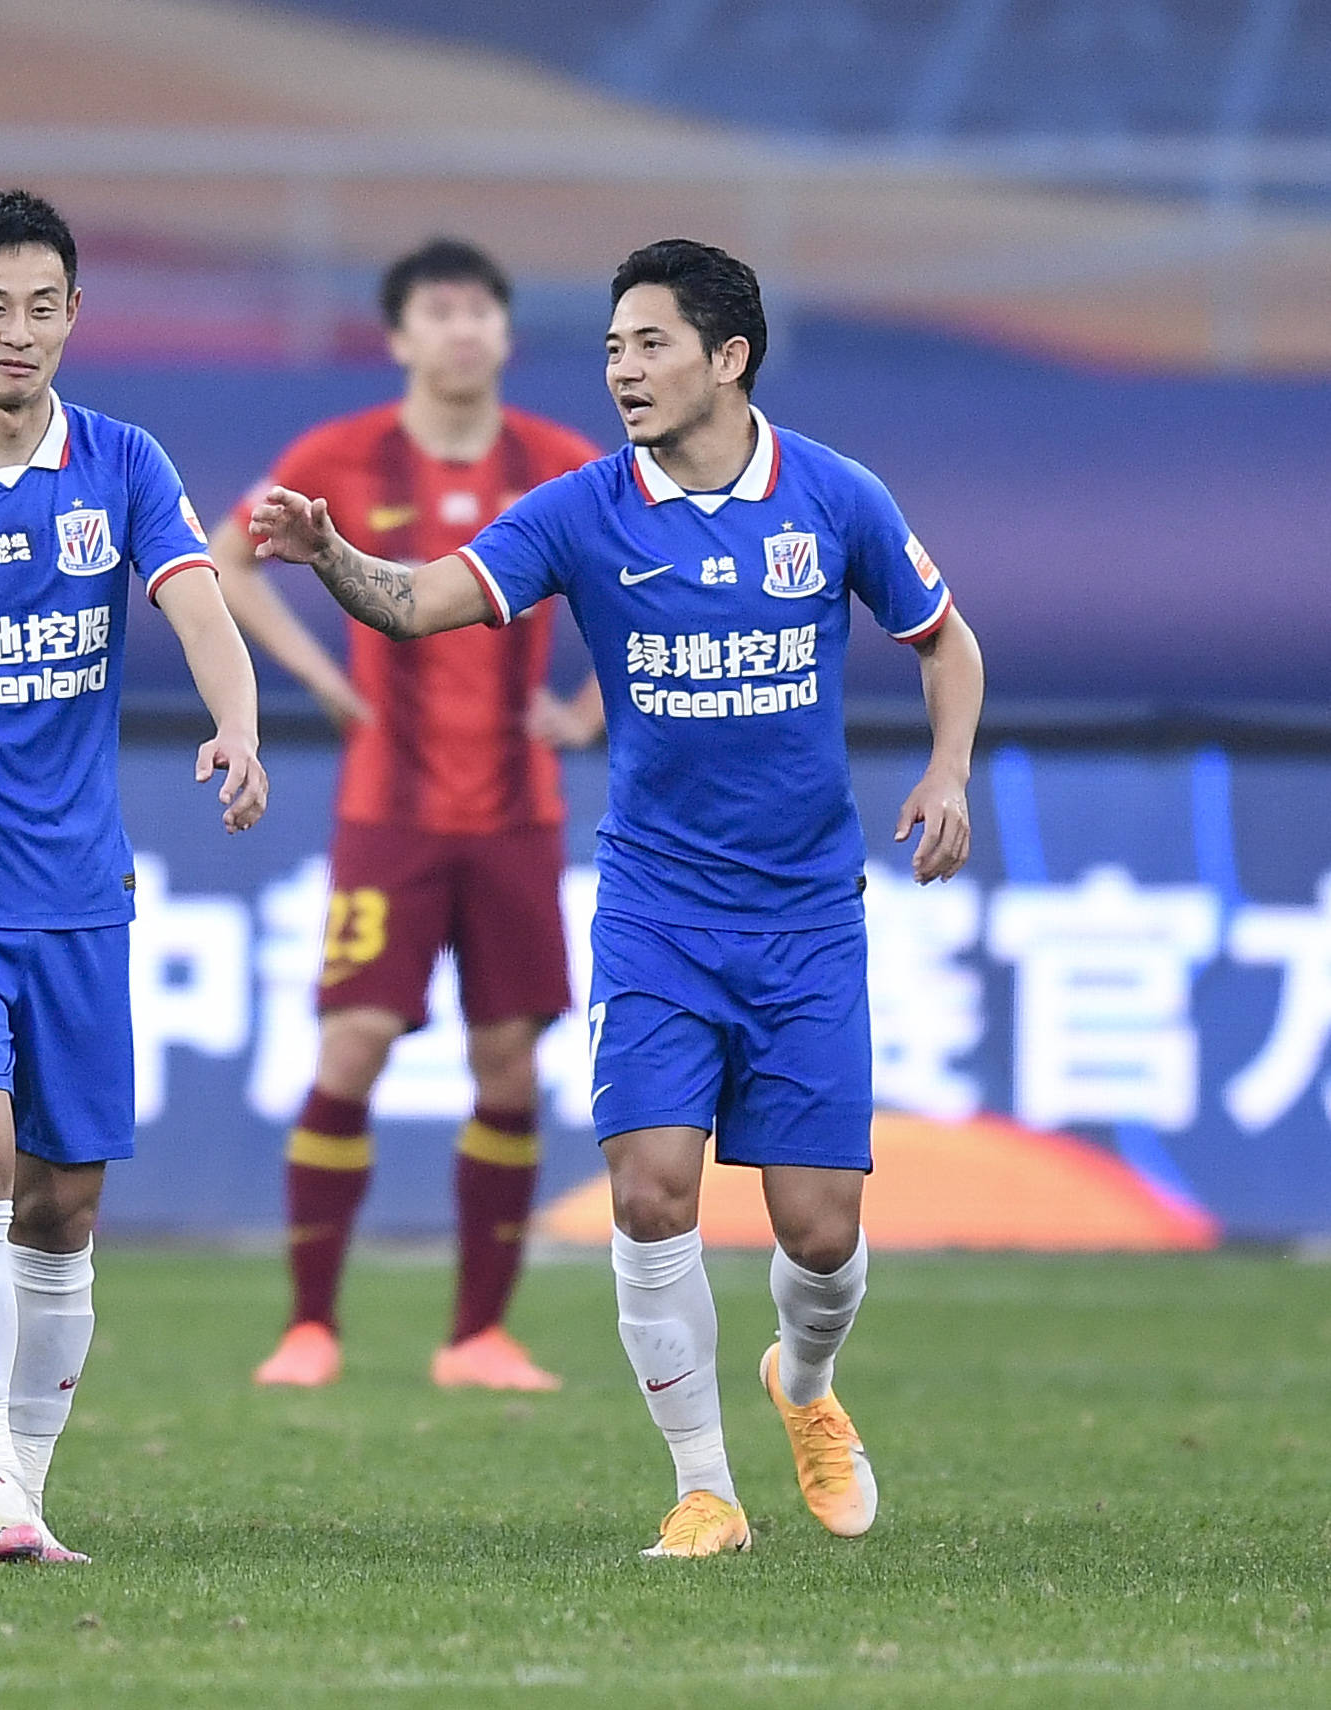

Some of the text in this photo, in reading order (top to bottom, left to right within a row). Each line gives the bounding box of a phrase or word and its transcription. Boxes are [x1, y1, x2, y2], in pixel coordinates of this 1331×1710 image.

[626, 623, 817, 680] 绿地控股
[629, 672, 818, 719] Greenland
